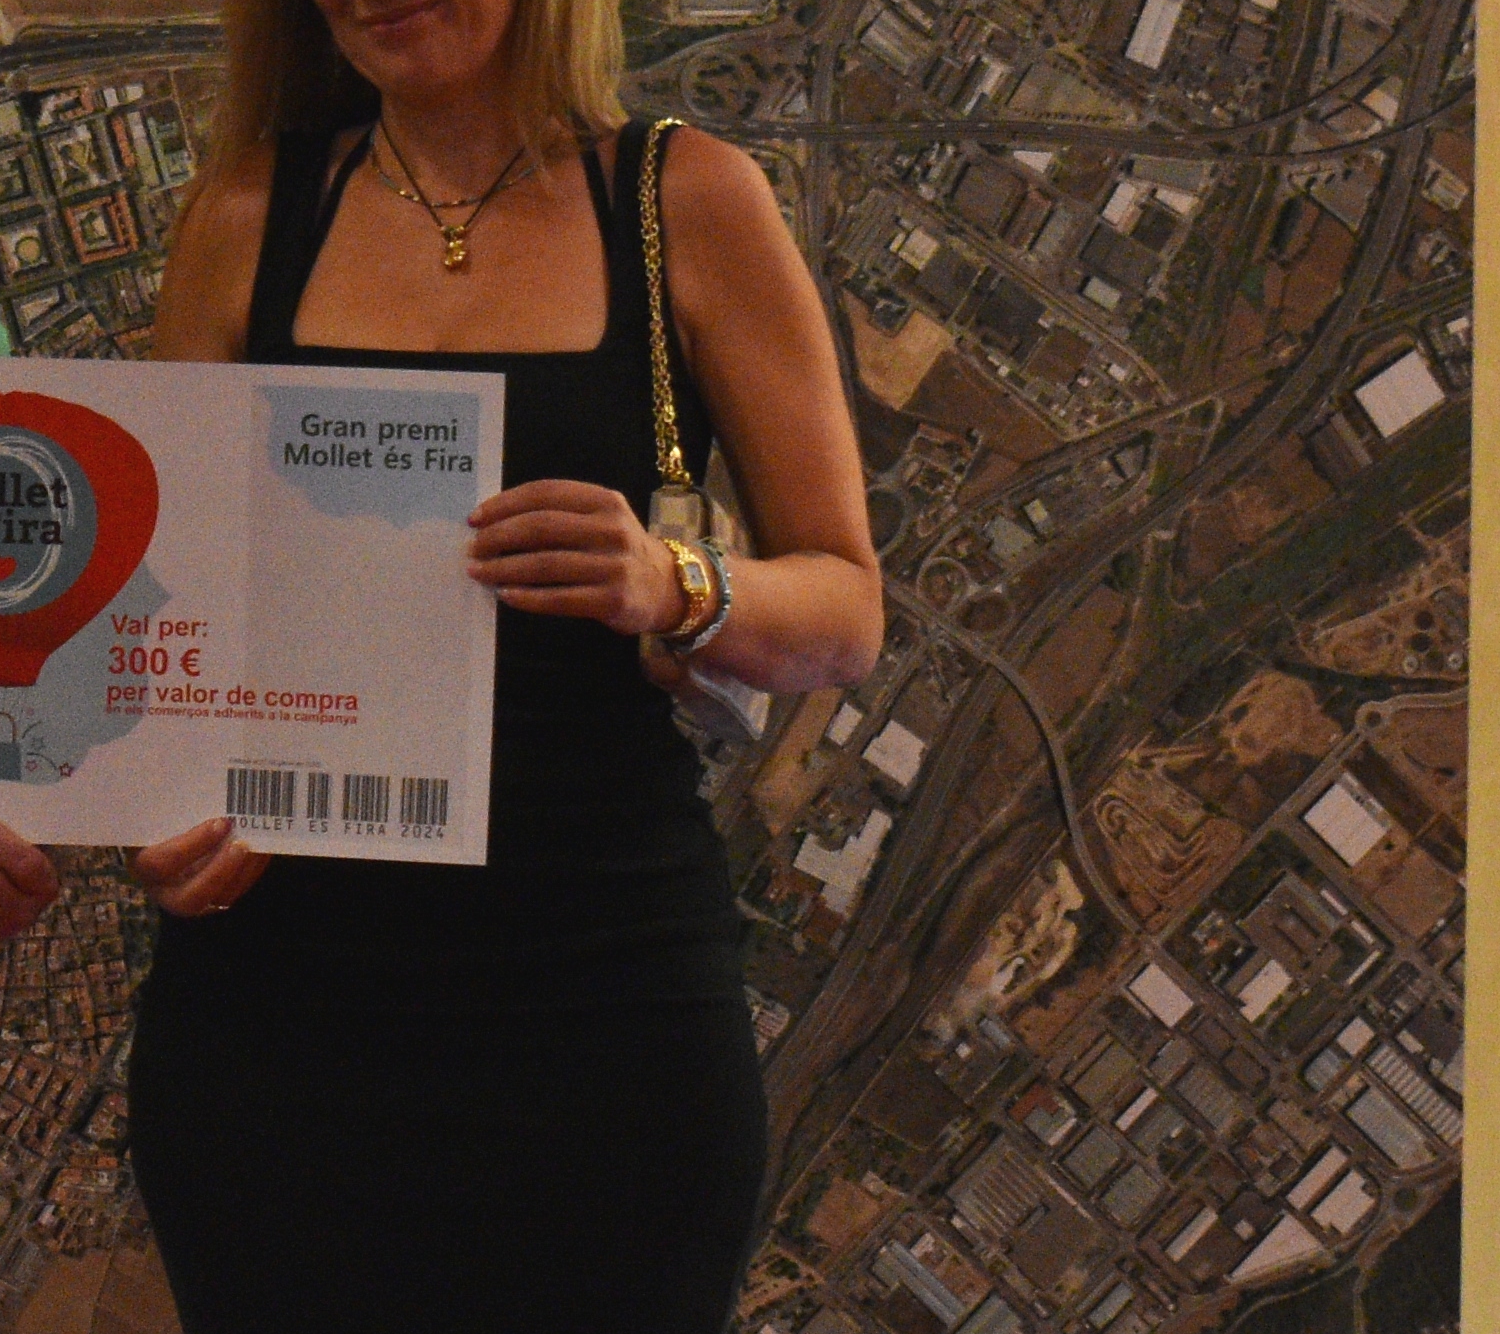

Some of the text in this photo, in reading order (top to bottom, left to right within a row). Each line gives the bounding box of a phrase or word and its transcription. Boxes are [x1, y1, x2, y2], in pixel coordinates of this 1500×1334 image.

[300, 413, 458, 446] Gran premi
[283, 442, 473, 473] Mollet és Fira
[110, 613, 209, 641] Val per:
[107, 645, 202, 678] 300 €
[106, 683, 360, 715] per valor de compra
[294, 712, 359, 727] campanya
[228, 816, 446, 839] MOLLET ES FIRA 2024
